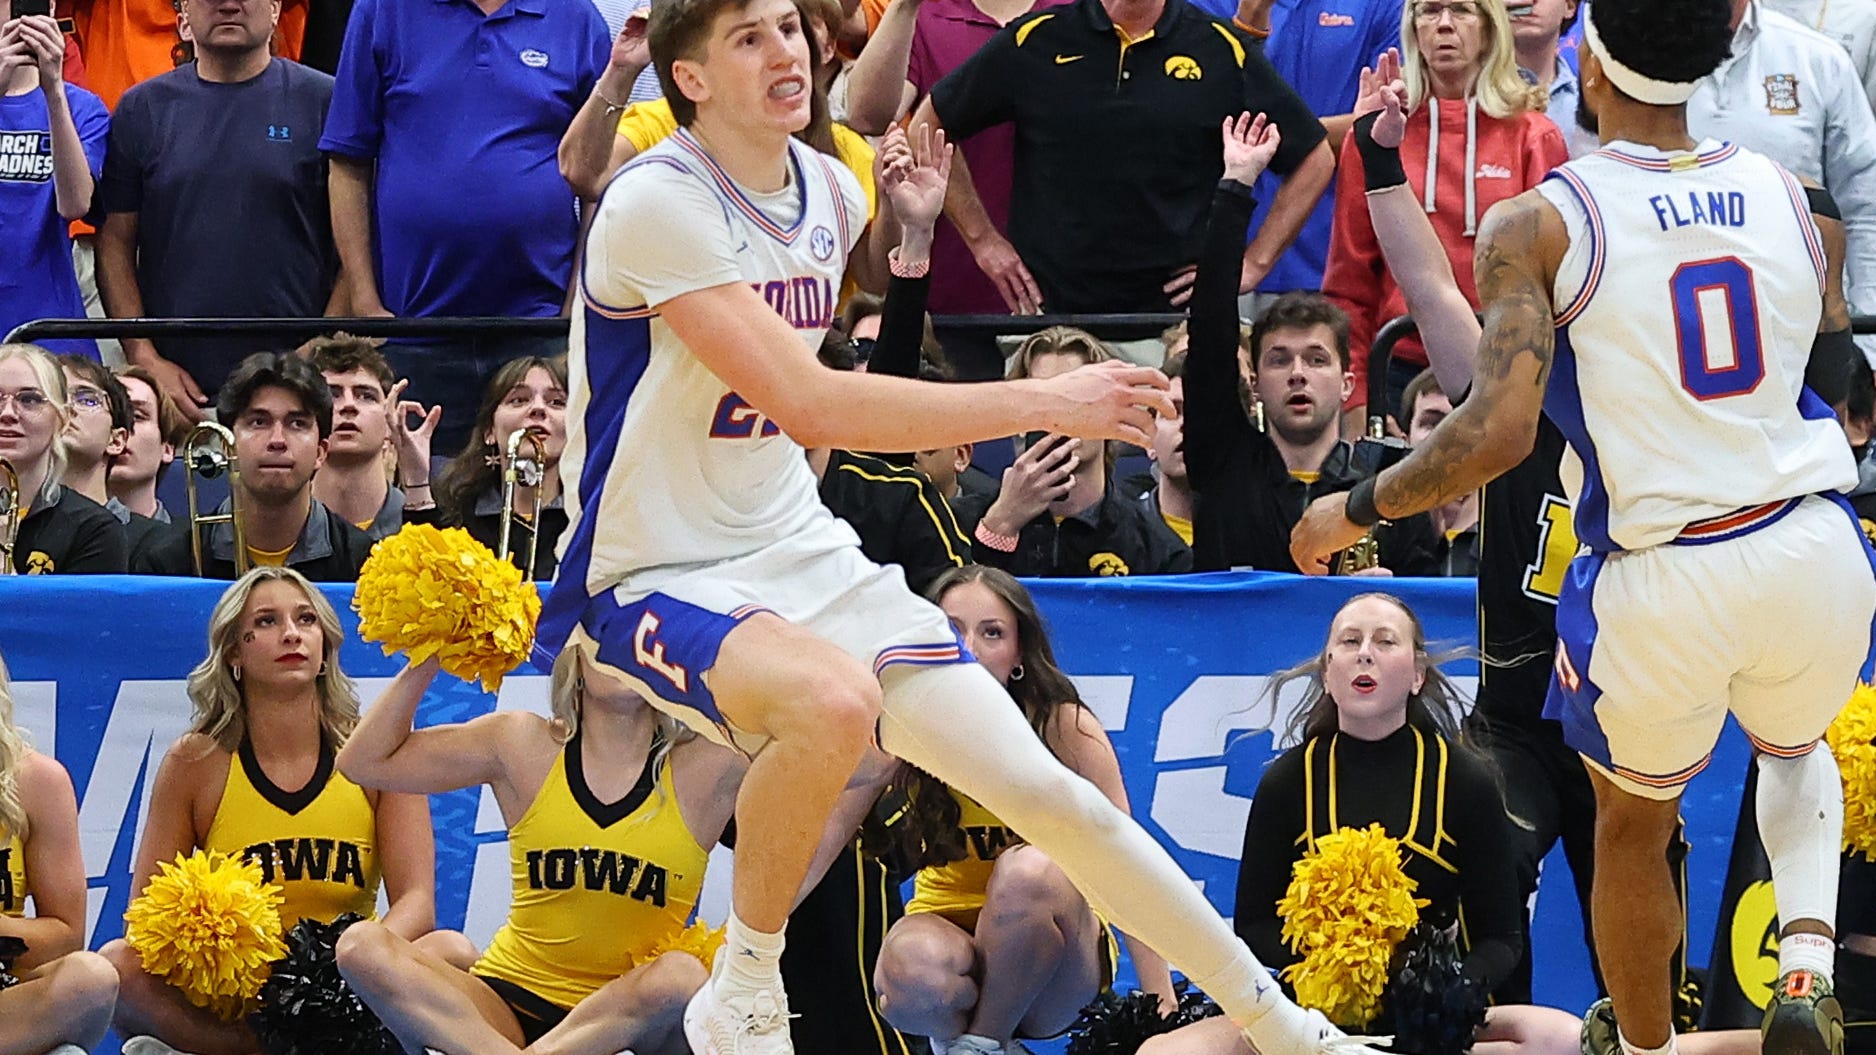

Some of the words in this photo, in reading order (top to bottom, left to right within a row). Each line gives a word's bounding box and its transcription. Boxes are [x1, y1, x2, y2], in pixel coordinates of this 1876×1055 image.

[0, 135, 39, 154] RCH
[0, 155, 54, 174] ADNES
[1649, 192, 1745, 232] FLAND
[751, 277, 833, 330] ORIDA
[1668, 255, 1766, 402] 0
[709, 391, 781, 439] 2
[232, 837, 366, 888] OWA
[526, 847, 669, 898] IOWA
